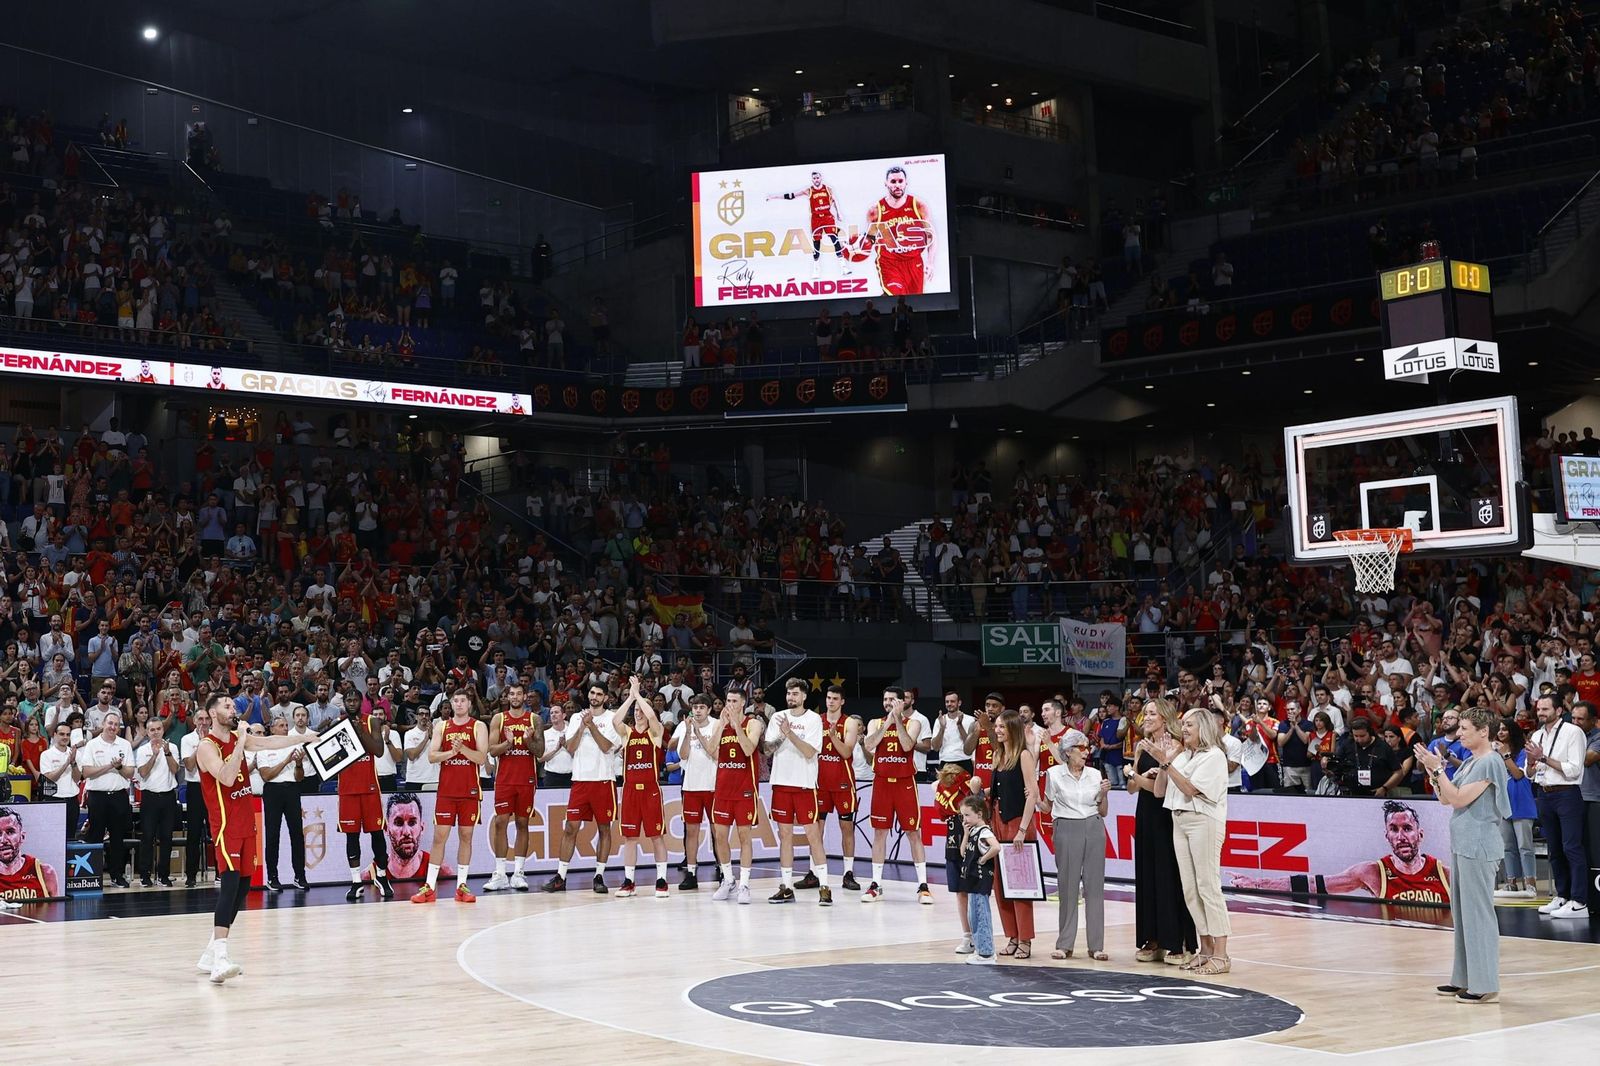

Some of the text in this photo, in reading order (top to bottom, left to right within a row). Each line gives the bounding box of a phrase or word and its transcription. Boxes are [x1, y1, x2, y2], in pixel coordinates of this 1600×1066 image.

[709, 219, 934, 260] GRACIAS
[718, 278, 868, 300] FERNÁNDEZ
[1394, 356, 1446, 375] LOTUS
[1463, 355, 1494, 369] LOTUS
[241, 373, 358, 399] GRACIAS
[391, 389, 497, 409] FERNÁNDEZ
[1074, 626, 1106, 637] RUDY
[1076, 639, 1113, 650] WIZINK
[1080, 659, 1114, 669] MENOS
[513, 736, 522, 745] 14
[826, 742, 832, 751] 4
[887, 742, 898, 752] 21
[636, 750, 642, 759] 9
[729, 748, 736, 758] 6
[818, 754, 840, 762] ndesa
[878, 756, 907, 764] endesa
[1048, 756, 1054, 765] 8
[627, 762, 653, 771] endesa
[729, 983, 1243, 1016] endesa
